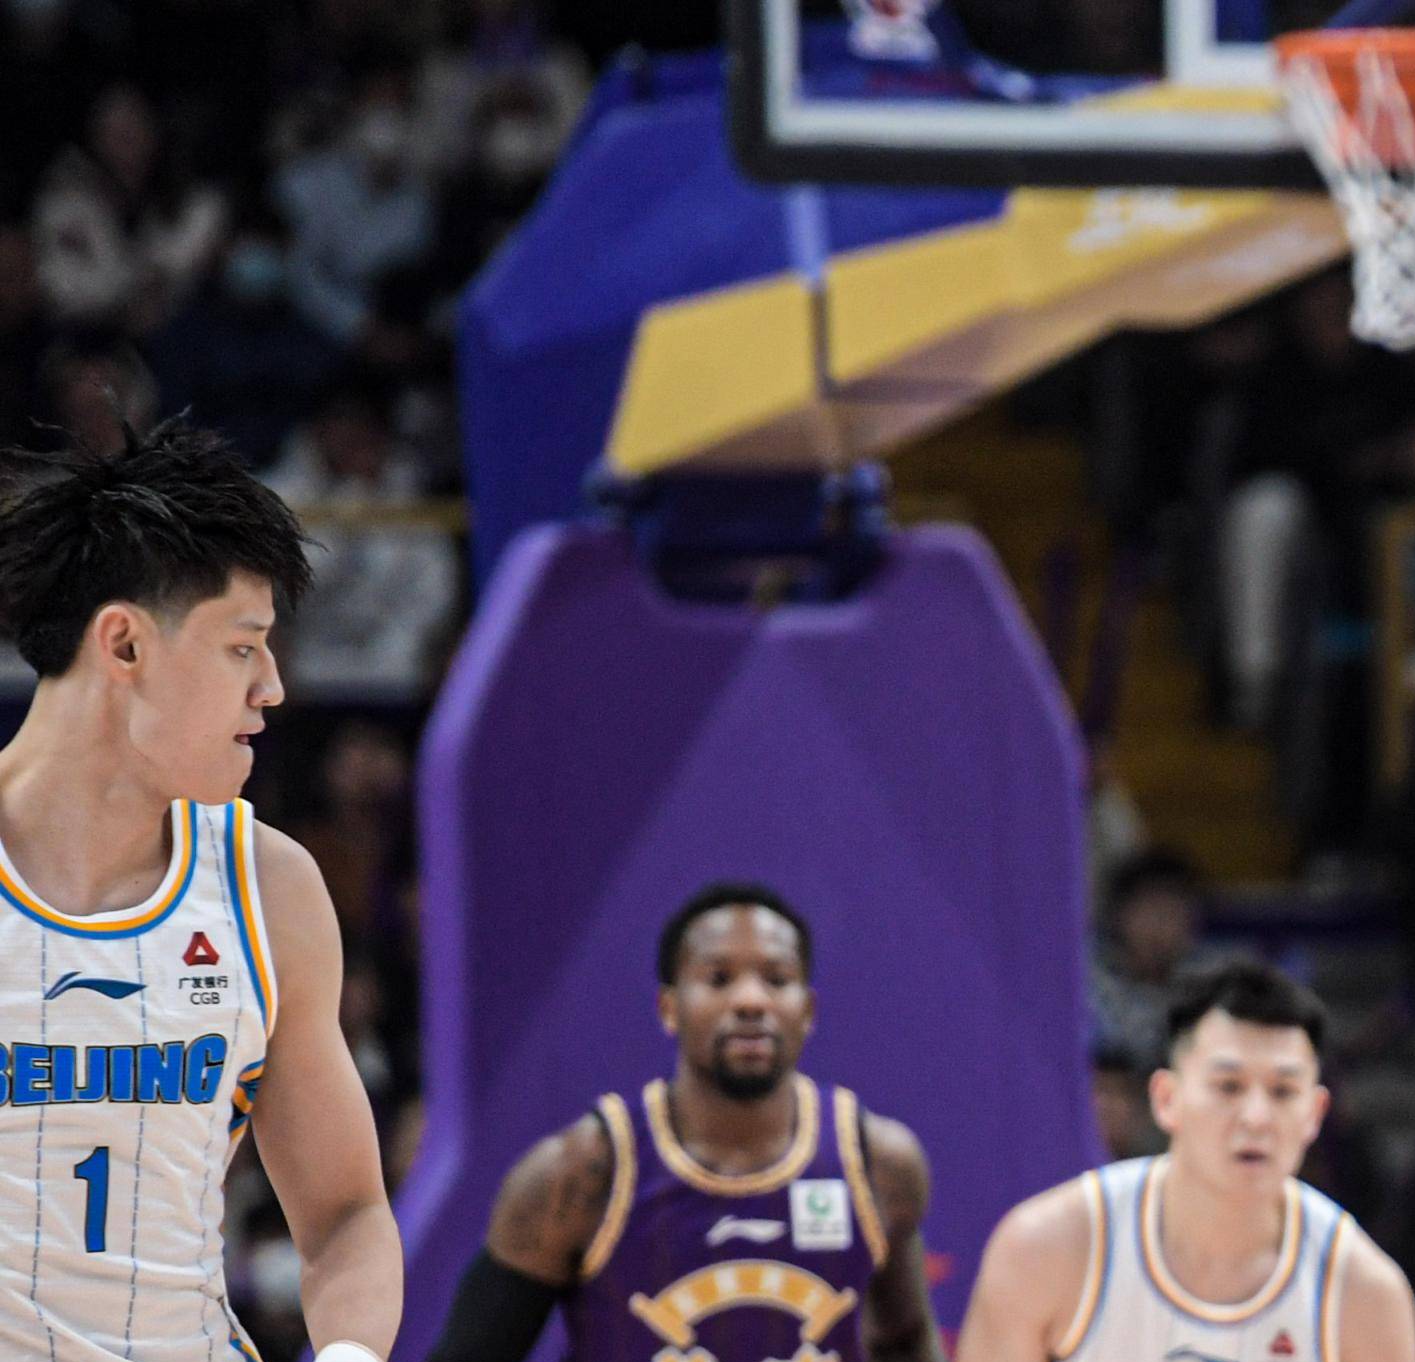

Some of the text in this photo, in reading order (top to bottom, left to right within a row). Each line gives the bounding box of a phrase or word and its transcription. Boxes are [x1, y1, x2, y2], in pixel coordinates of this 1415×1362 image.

[189, 991, 221, 1005] CGB
[0, 1033, 228, 1107] EIJING
[73, 1146, 109, 1253] 1
